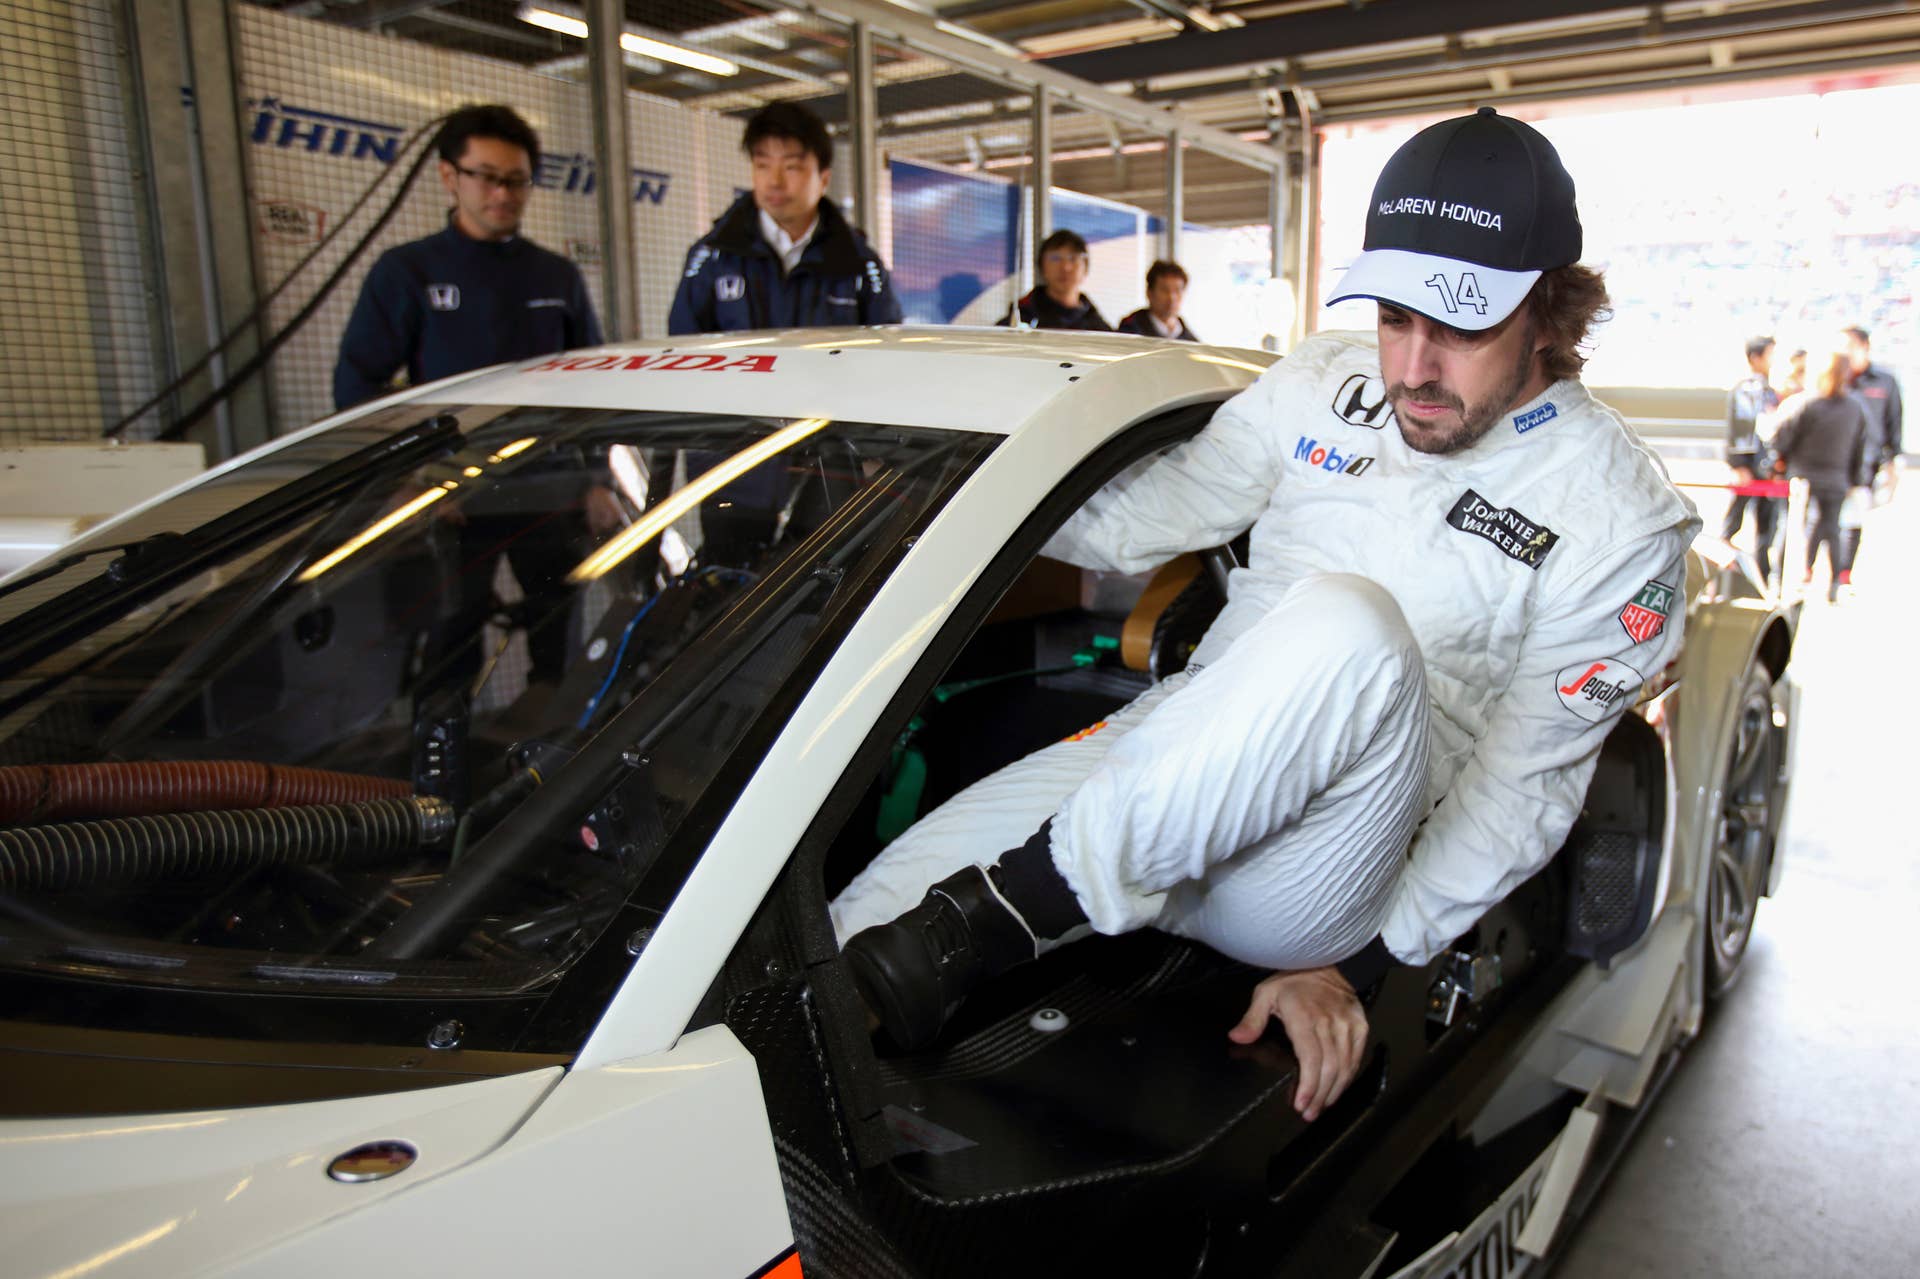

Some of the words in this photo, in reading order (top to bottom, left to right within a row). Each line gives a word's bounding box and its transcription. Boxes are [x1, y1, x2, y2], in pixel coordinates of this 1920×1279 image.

[1378, 198, 1436, 216] McLAREN
[1440, 202, 1502, 232] HONDA
[1425, 273, 1488, 315] 14
[519, 354, 778, 373] HONDA
[1294, 436, 1354, 473] Mobi
[1461, 514, 1523, 557] WALKER
[1462, 498, 1534, 540] JOHNNIE
